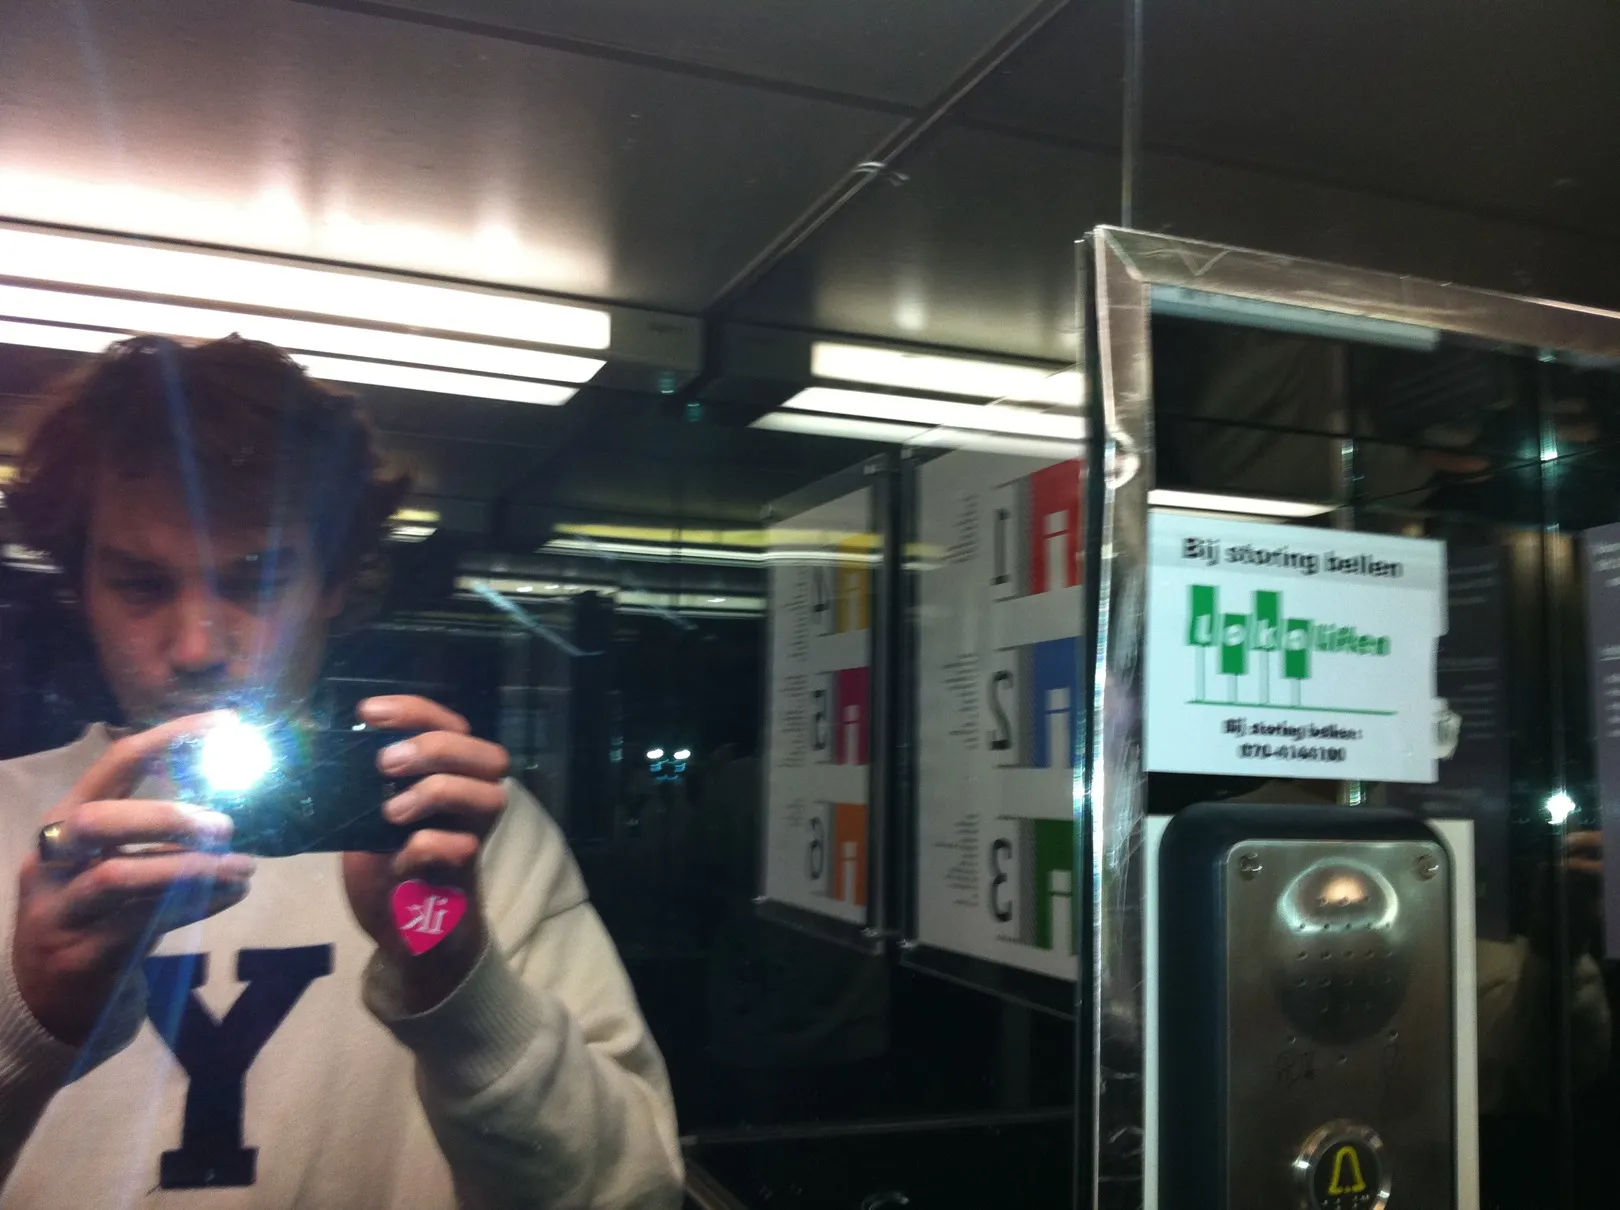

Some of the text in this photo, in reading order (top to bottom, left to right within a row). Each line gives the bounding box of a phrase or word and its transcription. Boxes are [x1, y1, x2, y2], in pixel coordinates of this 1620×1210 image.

[1182, 537, 1404, 578] Bij storing bellen
